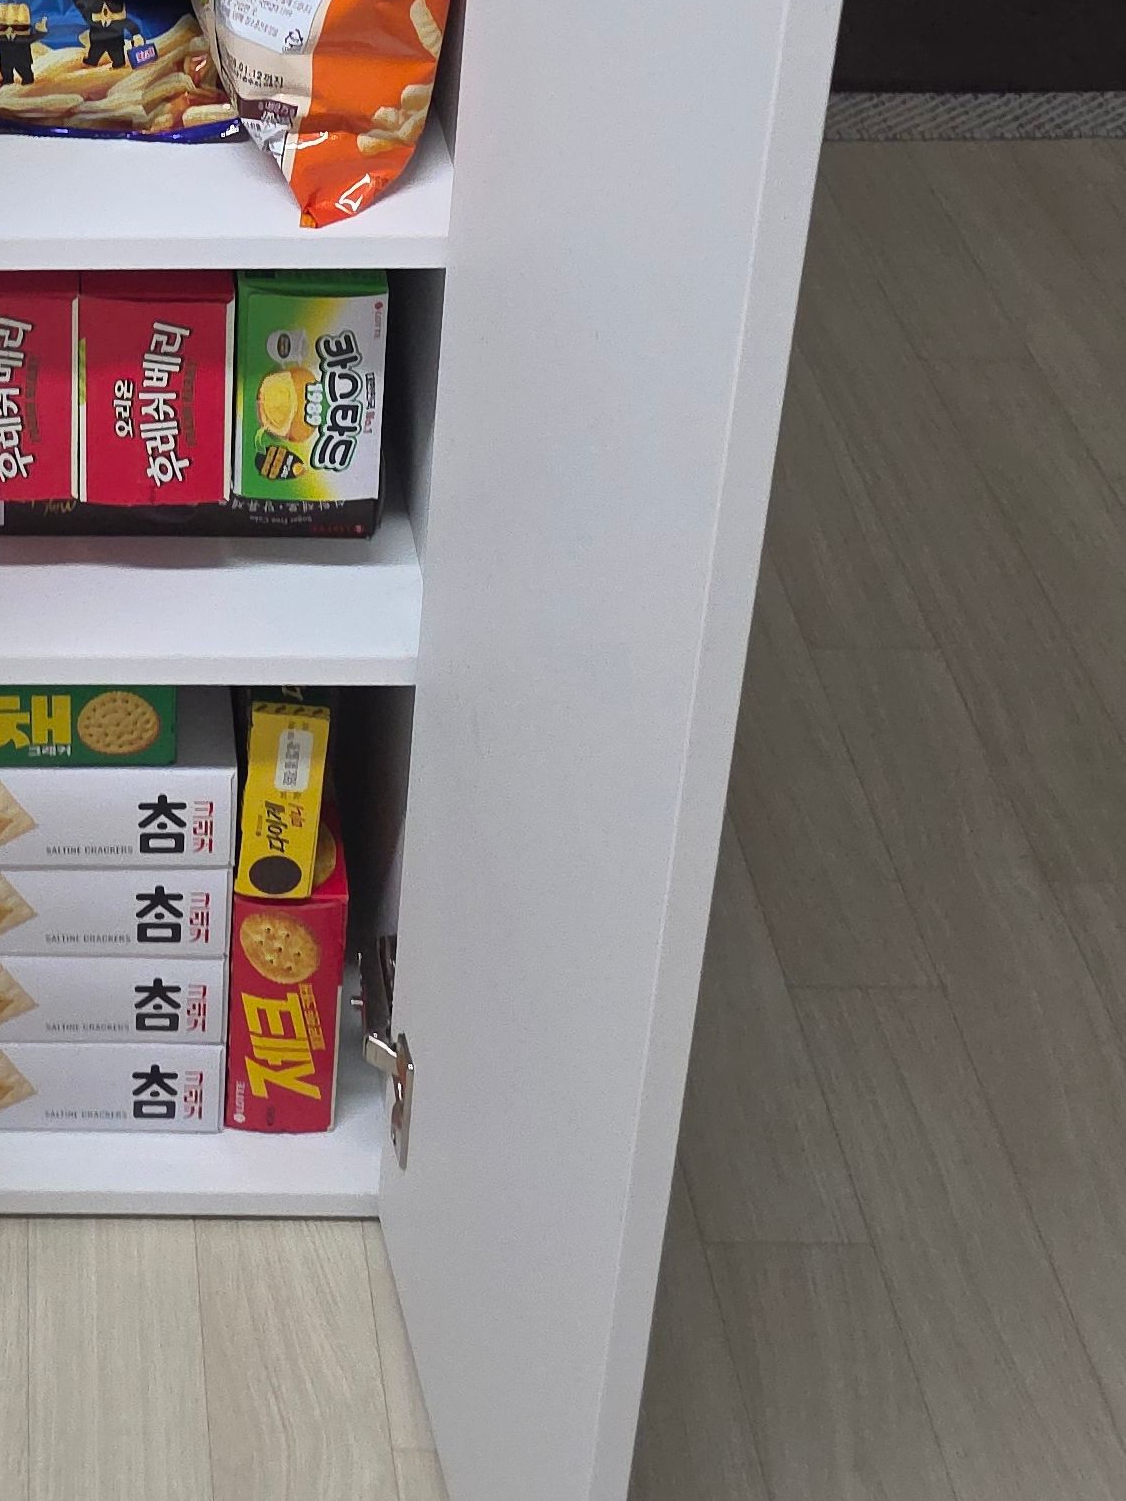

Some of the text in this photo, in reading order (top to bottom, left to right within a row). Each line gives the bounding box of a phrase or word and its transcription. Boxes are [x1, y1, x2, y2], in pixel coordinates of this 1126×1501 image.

[112, 378, 134, 439] 오리온
[138, 320, 192, 489] 후레쉬베리
[305, 382, 324, 428] 1989
[310, 330, 363, 472] 카스타드
[28, 745, 72, 757] 크래커
[46, 845, 134, 855] SALTINE CRACKERS
[192, 800, 214, 854] 크래커
[264, 799, 290, 854] 다이제
[45, 934, 131, 944] SALTINE CRACKERS
[189, 891, 210, 944] 크래커
[45, 1023, 130, 1033] SALTINE CRACKERS
[185, 983, 207, 1033] 크래커
[241, 991, 322, 1100] 제크
[44, 1110, 128, 1120] SALTINE CRACKERS
[182, 1070, 204, 1120] 크래커
[235, 1080, 245, 1114] LOTTE
